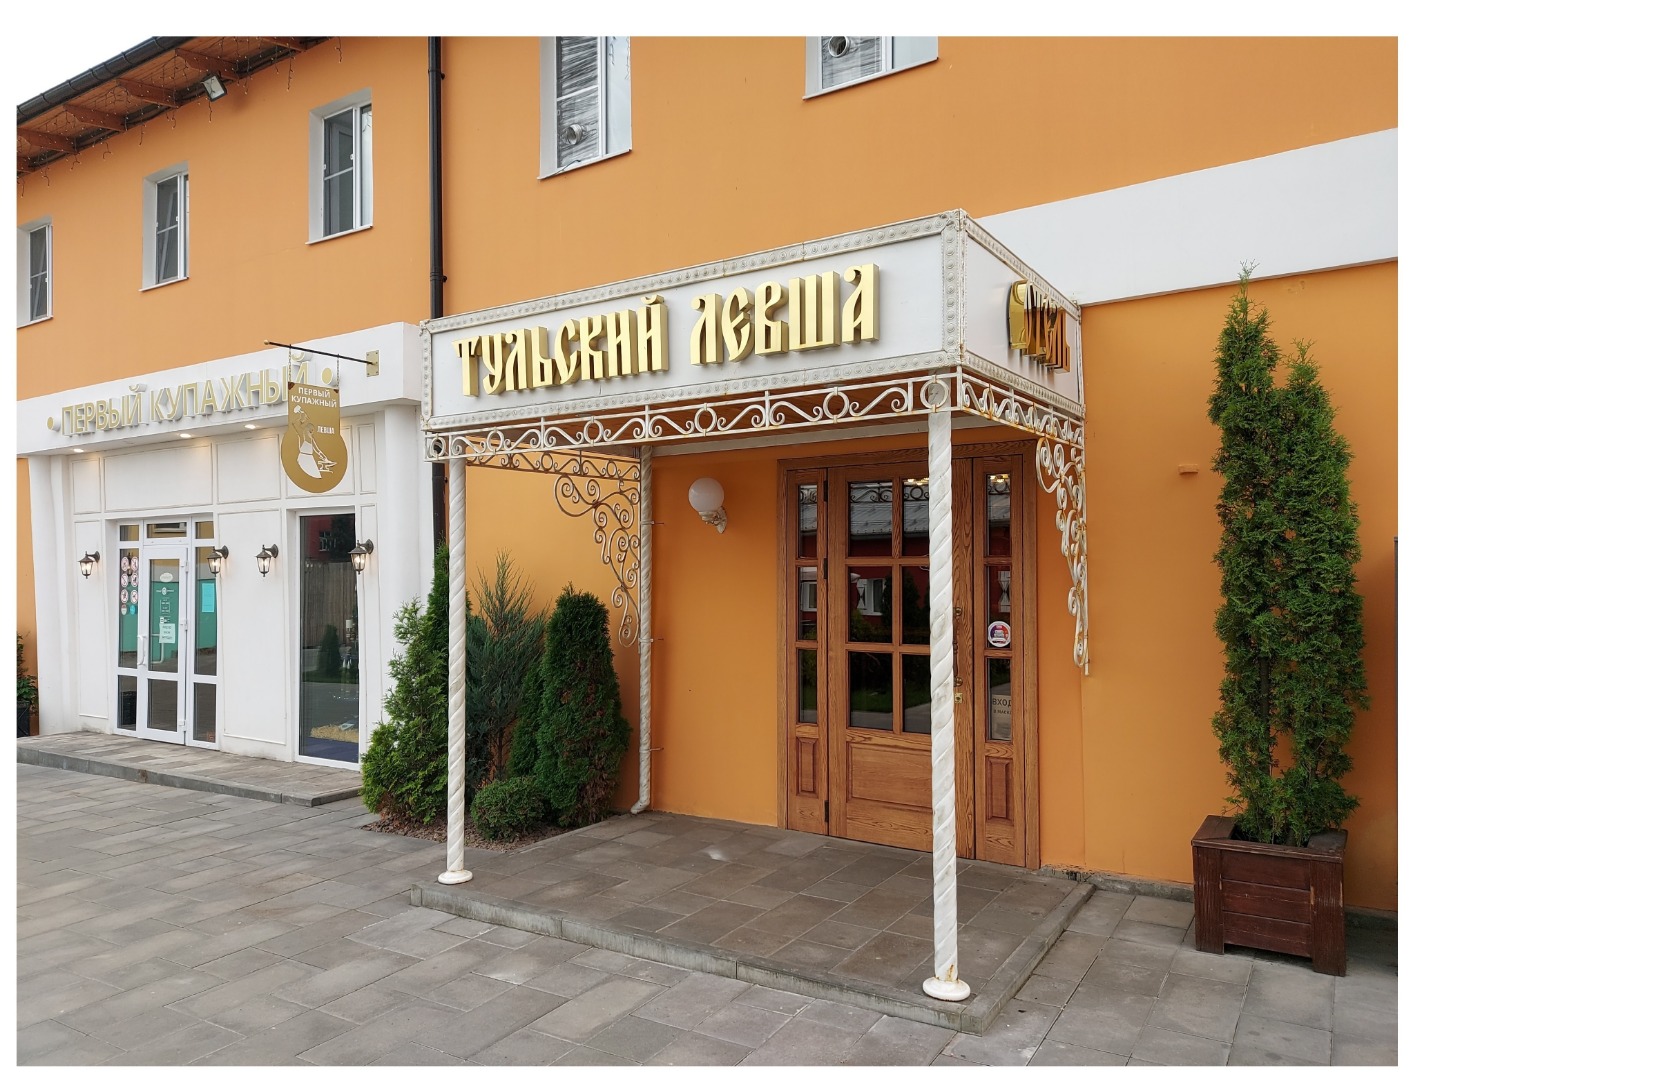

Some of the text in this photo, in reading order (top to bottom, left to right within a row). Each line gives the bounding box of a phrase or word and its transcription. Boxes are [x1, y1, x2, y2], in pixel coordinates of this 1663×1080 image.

[452, 263, 880, 397] ТУЛЬСКИЙ ЛЕВША
[291, 395, 337, 408] КУПАЖНЫЙ
[298, 386, 331, 398] ПЕРВЫЙ
[61, 384, 146, 436] ПЕРВЫЙ
